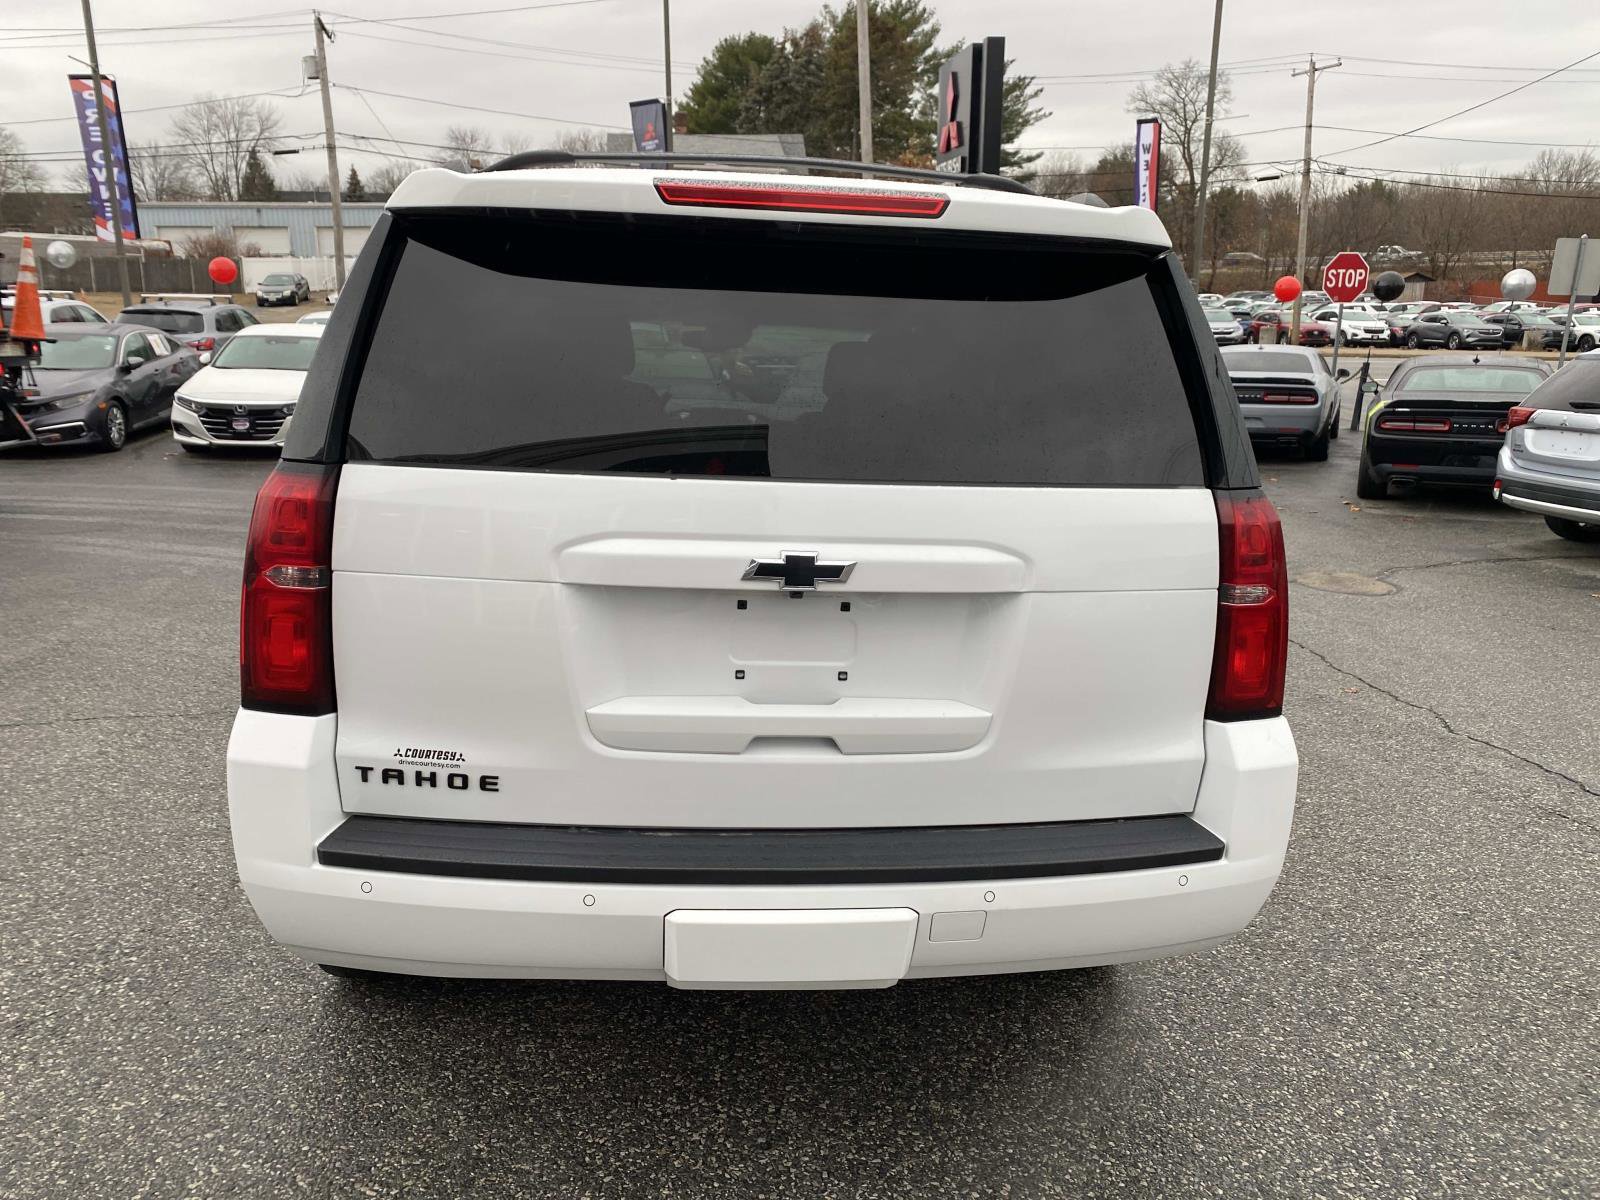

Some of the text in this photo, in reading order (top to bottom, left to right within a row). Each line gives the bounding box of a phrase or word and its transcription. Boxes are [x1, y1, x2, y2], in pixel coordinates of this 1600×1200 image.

[1326, 268, 1366, 288] STOP
[404, 748, 457, 761] COURTESY
[398, 758, 461, 769] drivecourtesy.com
[354, 765, 500, 792] TAHOE
